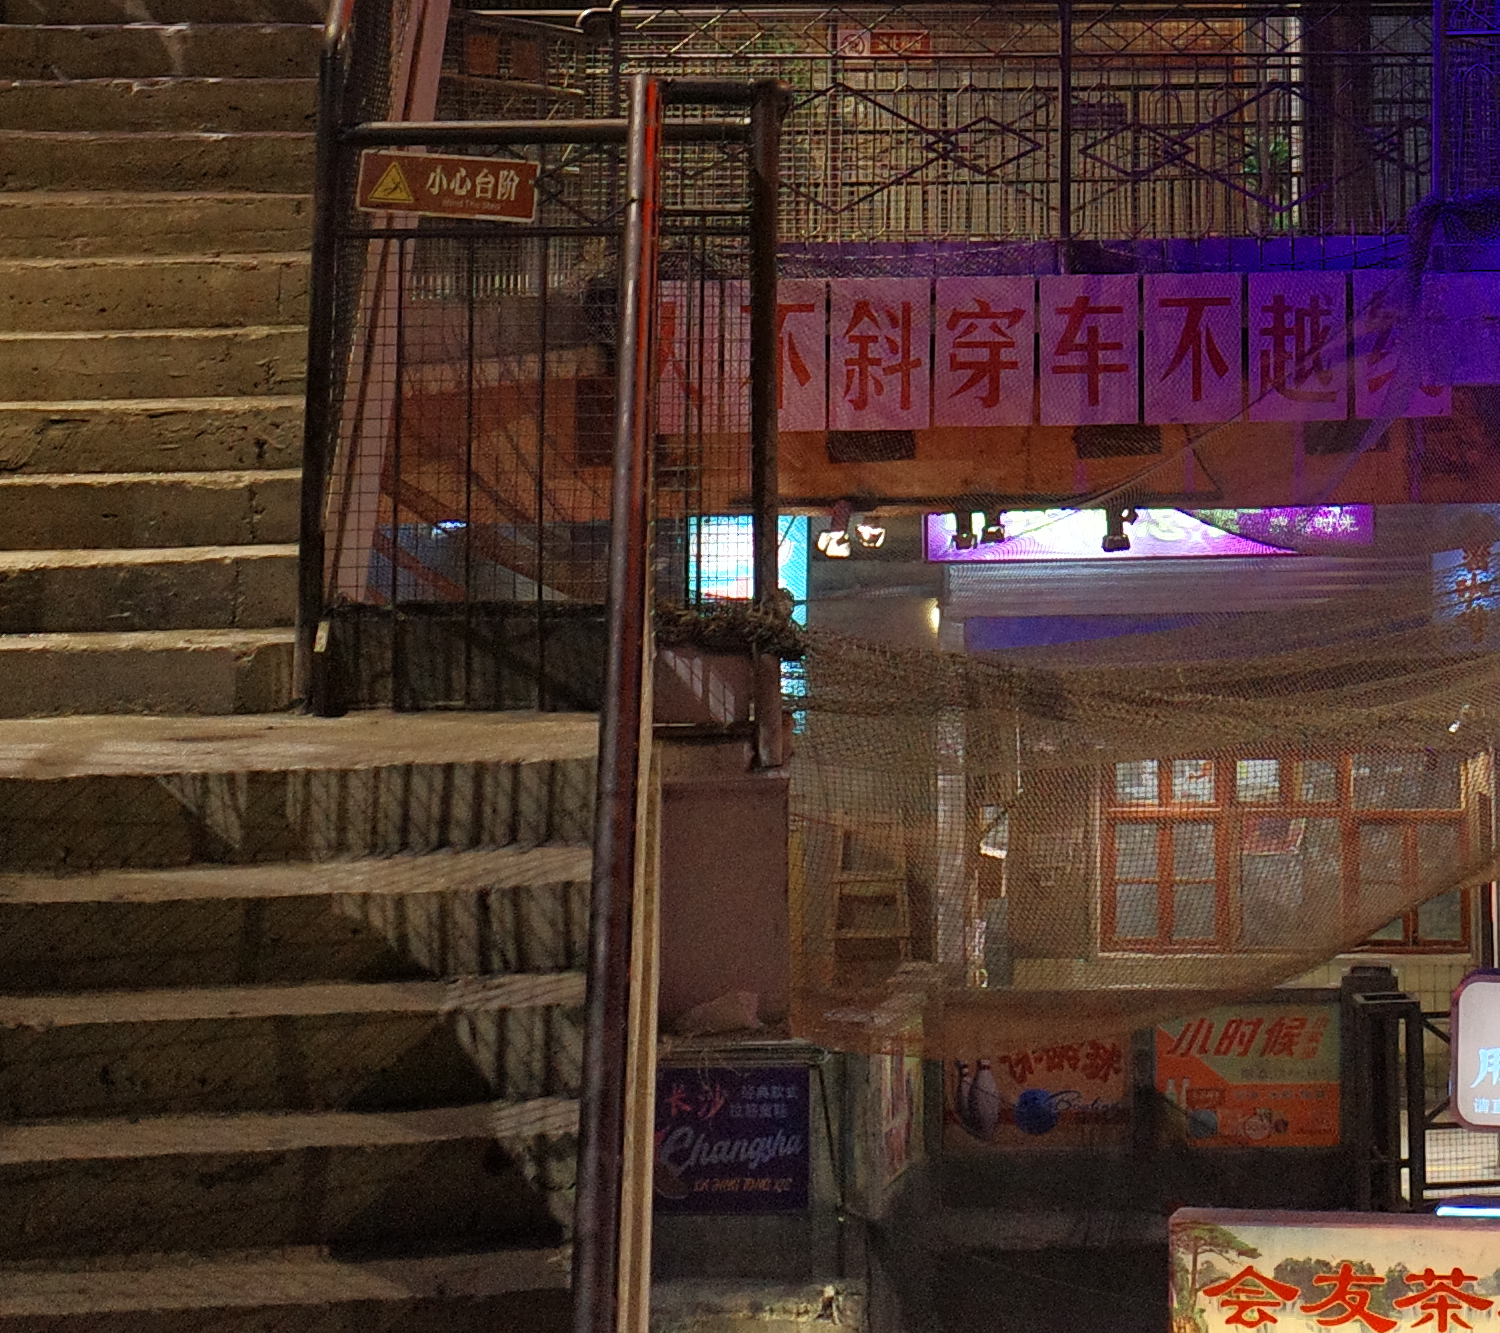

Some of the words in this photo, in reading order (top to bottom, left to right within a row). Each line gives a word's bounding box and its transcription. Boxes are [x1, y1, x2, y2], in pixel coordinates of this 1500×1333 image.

[425, 165, 521, 202] 小心台阶
[1166, 1017, 1307, 1058] 小时候
[658, 1125, 803, 1178] Changsha
